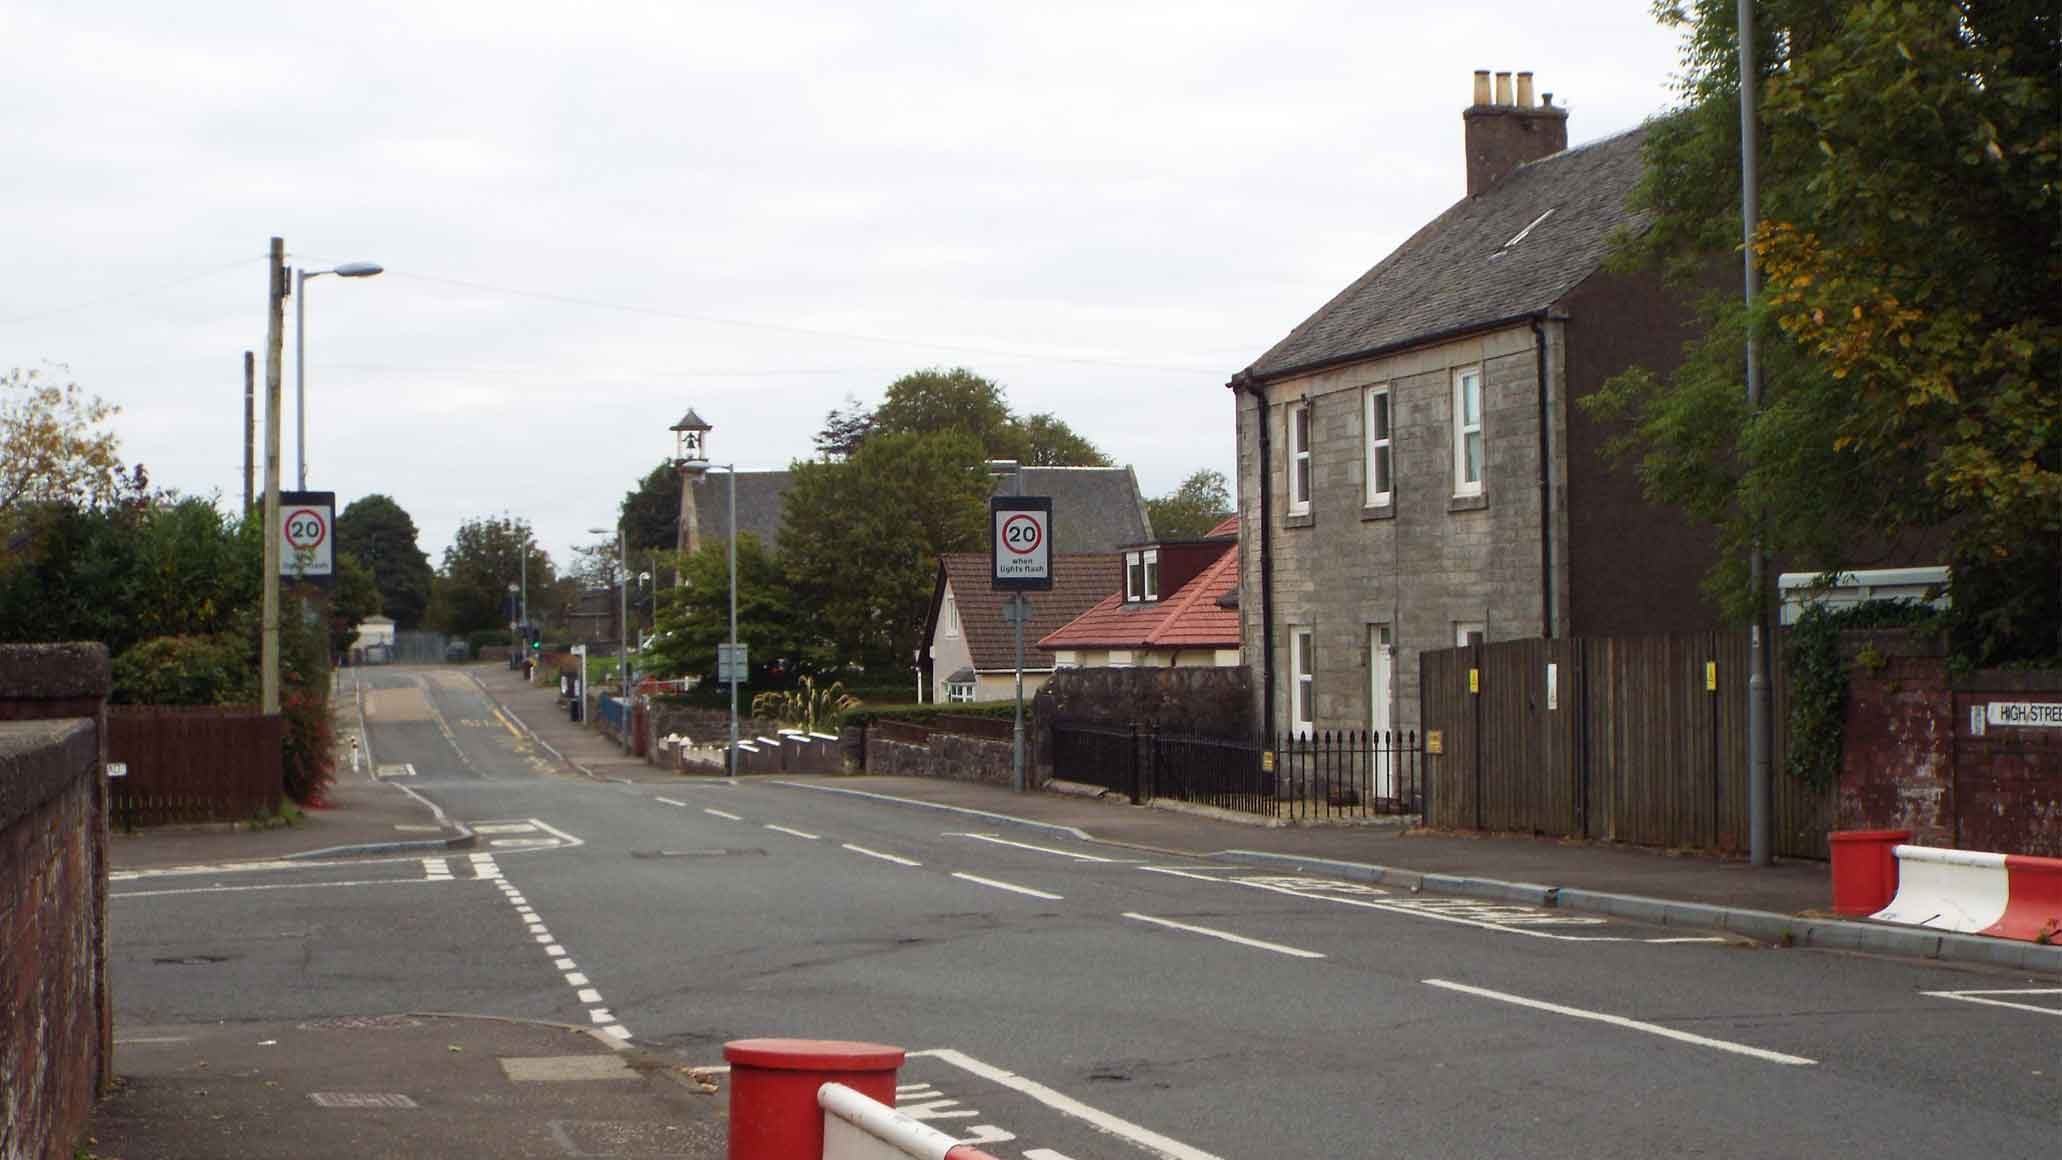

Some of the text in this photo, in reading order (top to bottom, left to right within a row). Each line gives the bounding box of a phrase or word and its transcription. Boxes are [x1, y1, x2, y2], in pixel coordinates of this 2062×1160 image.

[291, 521, 319, 538] 20
[1008, 526, 1036, 542] 20
[1000, 565, 1044, 574] lights flash
[2000, 704, 2026, 721] HIGH
